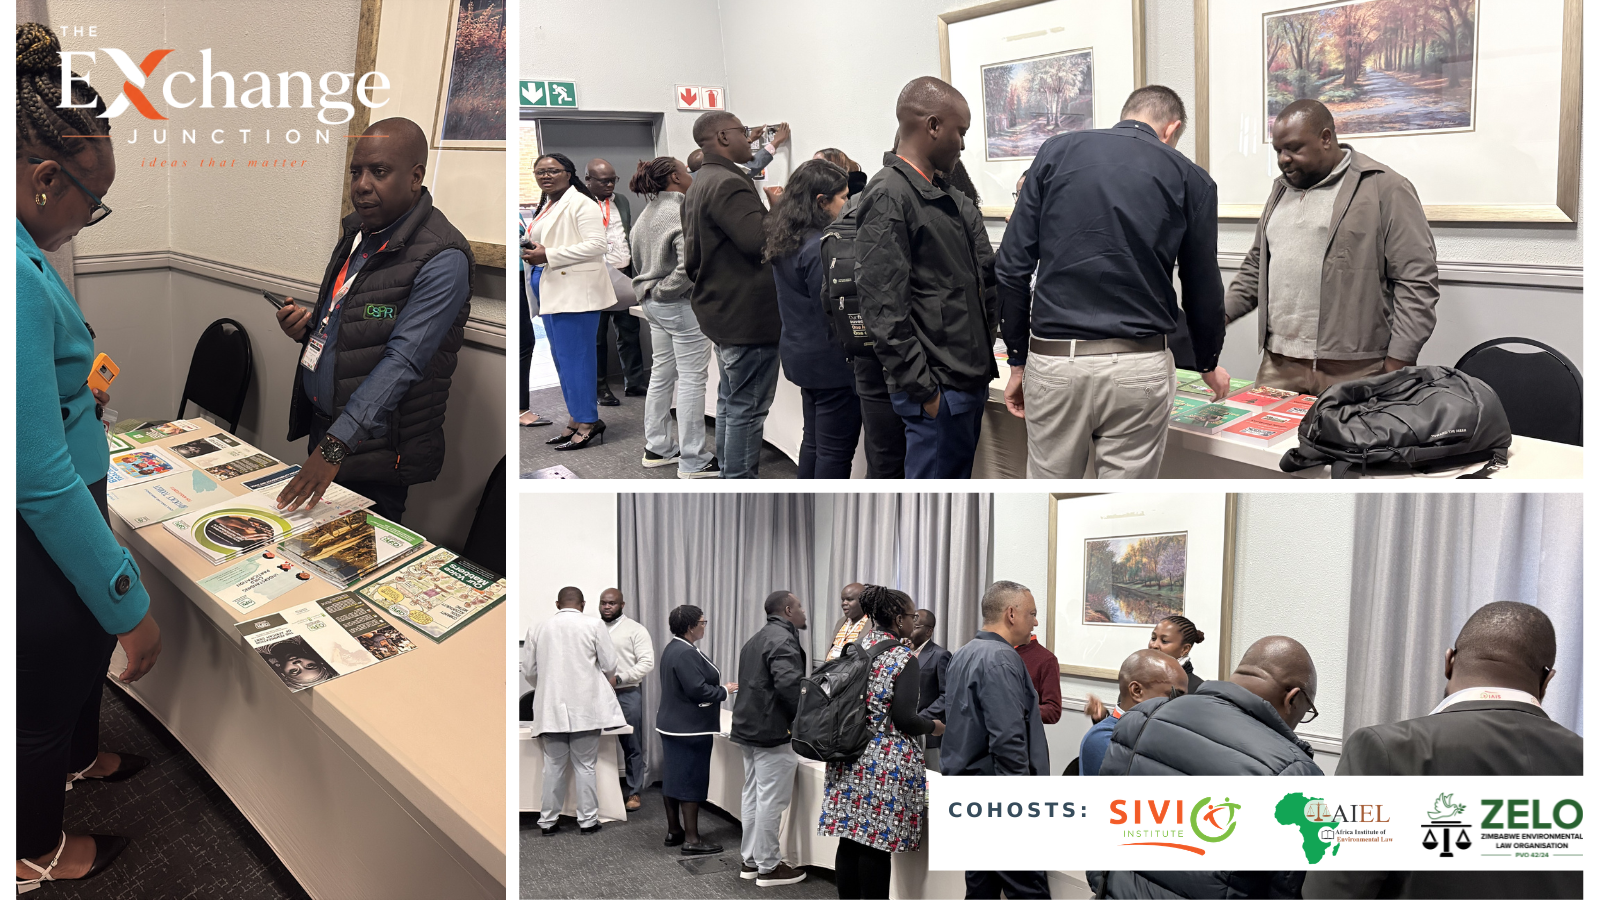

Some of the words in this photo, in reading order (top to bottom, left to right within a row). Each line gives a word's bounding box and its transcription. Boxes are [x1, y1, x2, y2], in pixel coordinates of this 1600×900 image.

[366, 305, 393, 318] CSPR
[443, 567, 466, 582] Voice
[448, 563, 489, 586] Matters
[464, 578, 482, 589] Our
